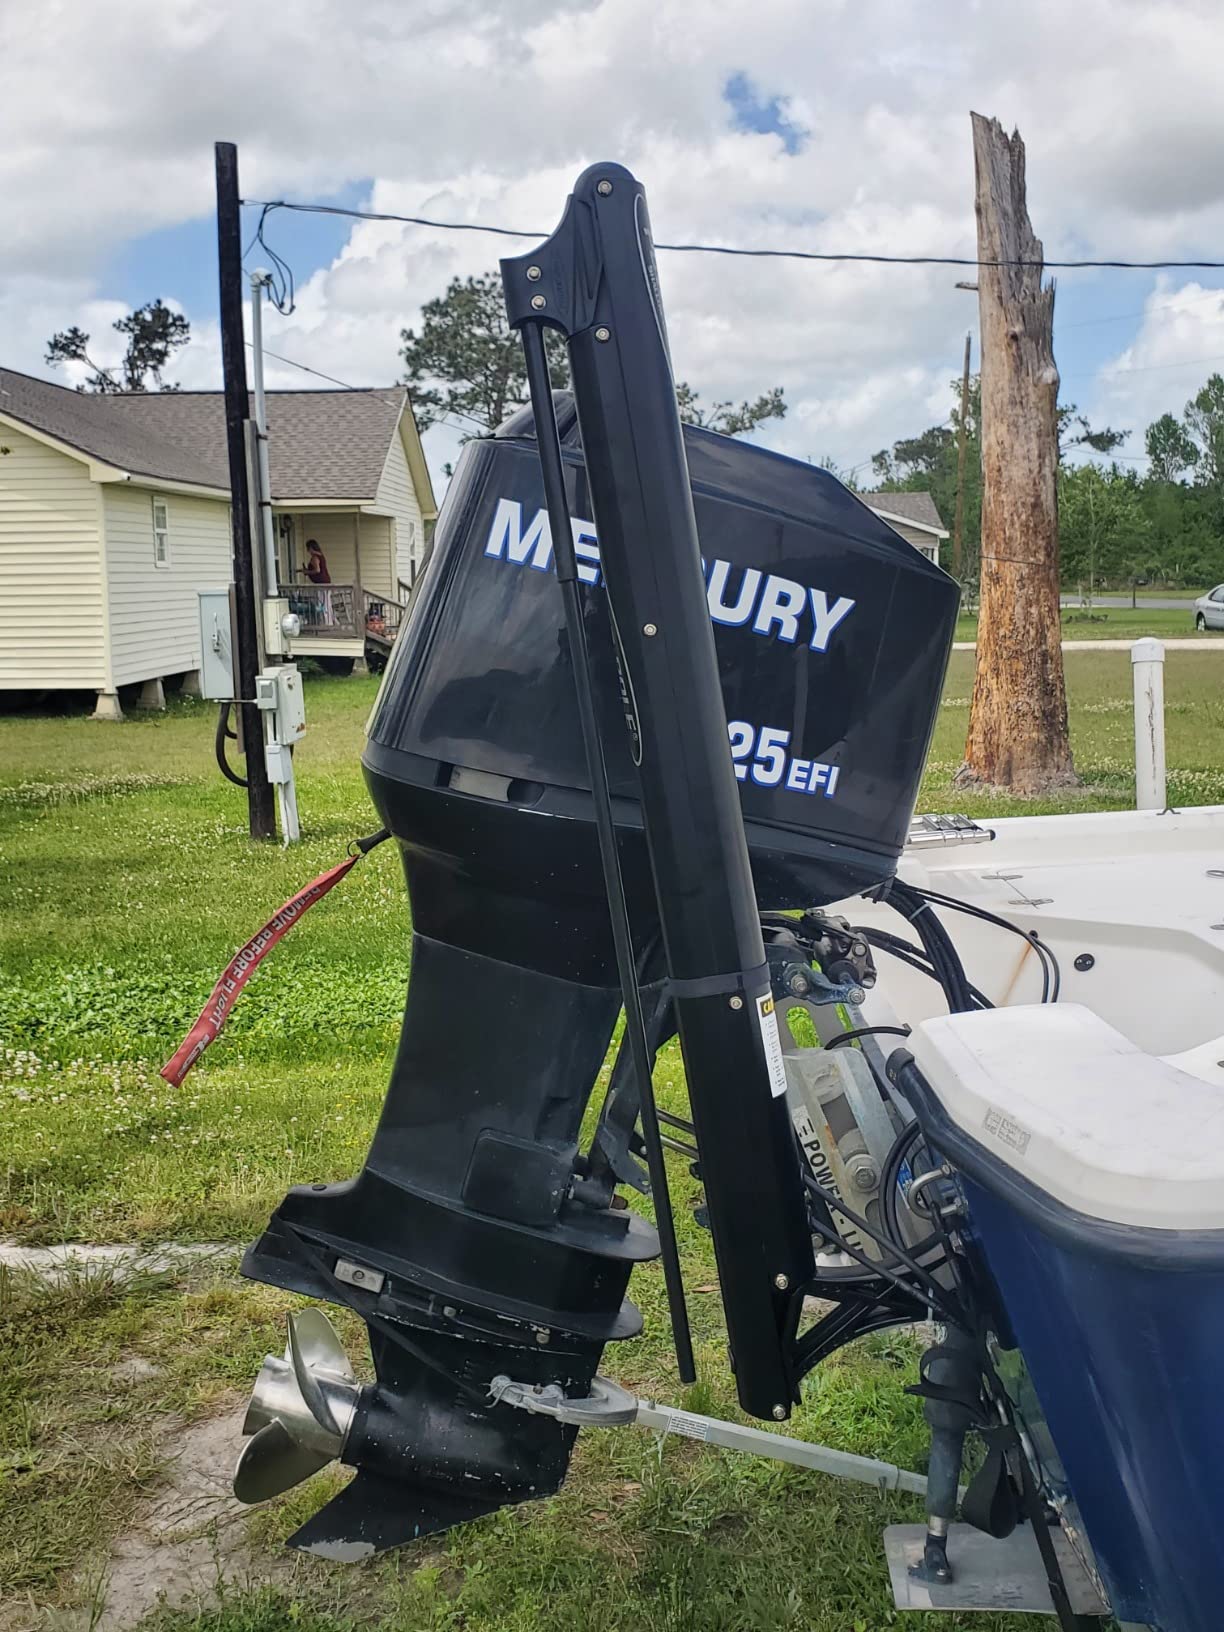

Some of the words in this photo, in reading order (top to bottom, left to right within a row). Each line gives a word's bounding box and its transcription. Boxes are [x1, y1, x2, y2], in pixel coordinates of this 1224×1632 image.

[484, 498, 856, 652] MEURY
[785, 758, 840, 799] EFI
[232, 929, 274, 980] BEFORE
[208, 979, 237, 1031] FLIGHT
